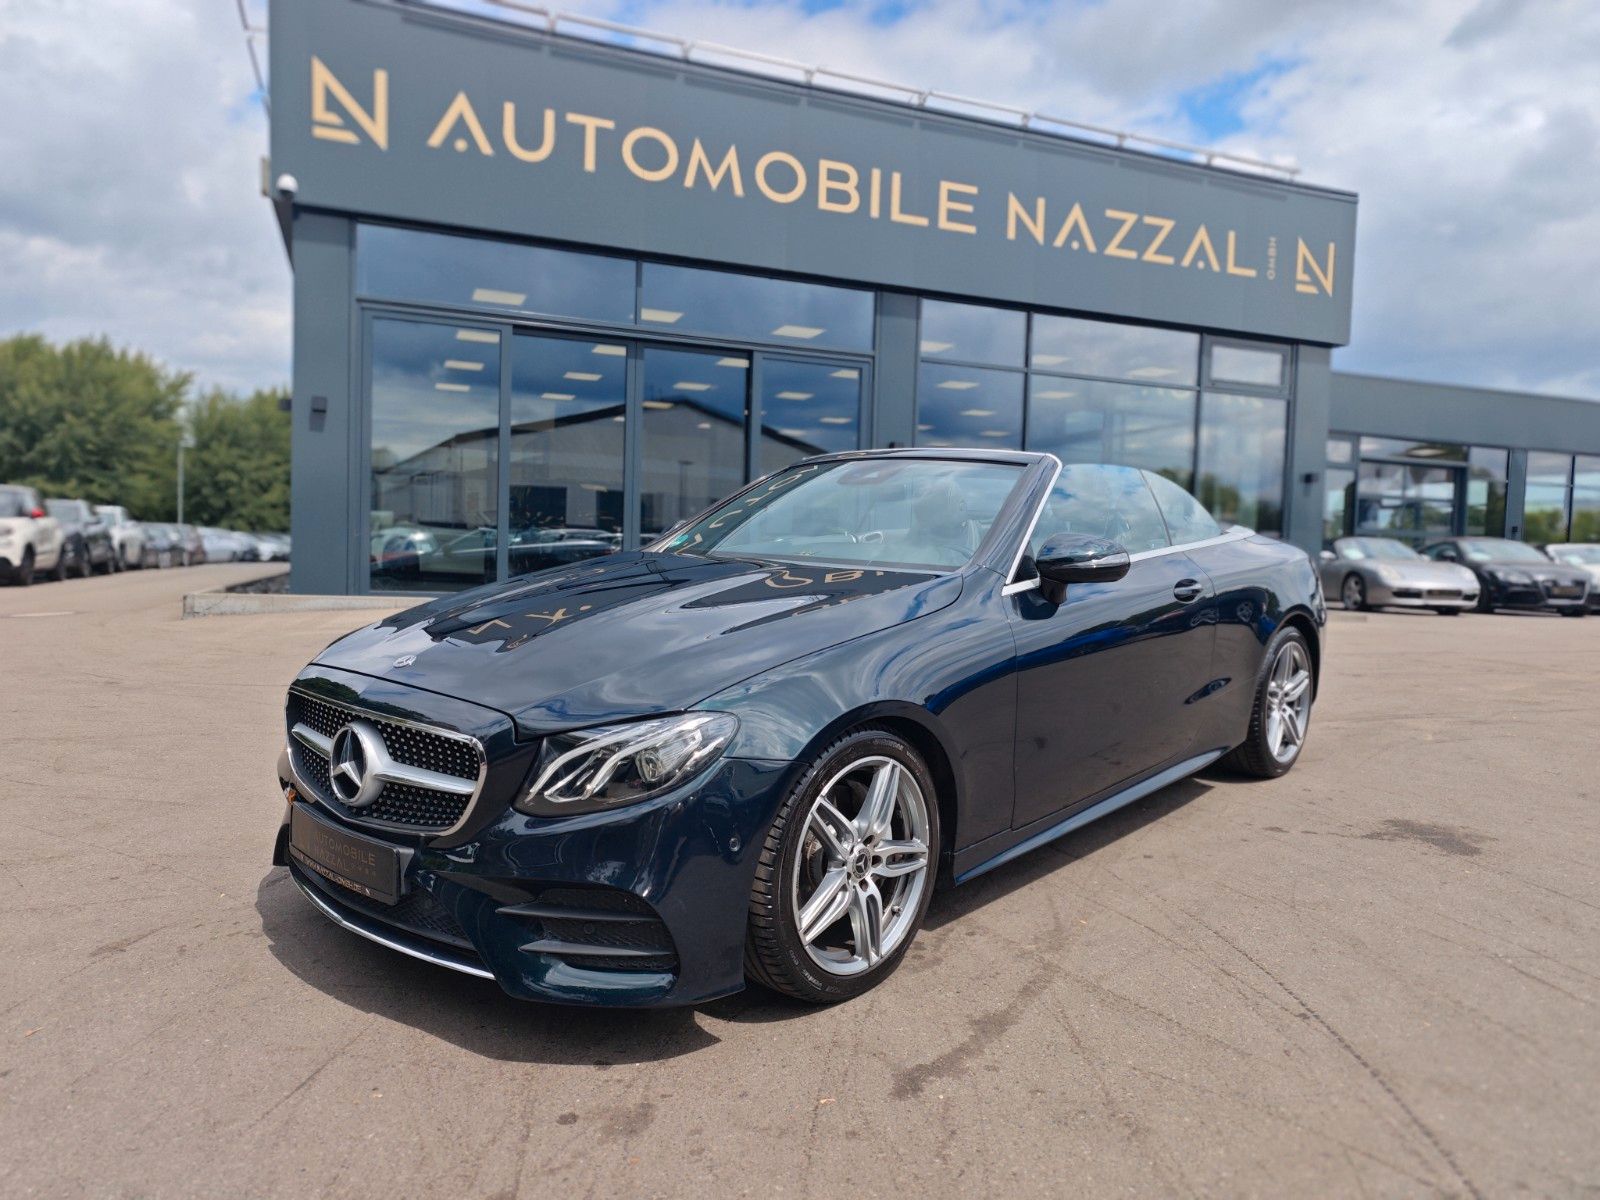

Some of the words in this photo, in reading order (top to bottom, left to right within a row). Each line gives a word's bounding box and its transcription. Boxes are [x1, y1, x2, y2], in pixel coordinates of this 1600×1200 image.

[426, 90, 979, 235] AUTOMOBILE
[1006, 192, 1258, 278] NAZZAL
[313, 831, 376, 867] AUTOMOBILE
